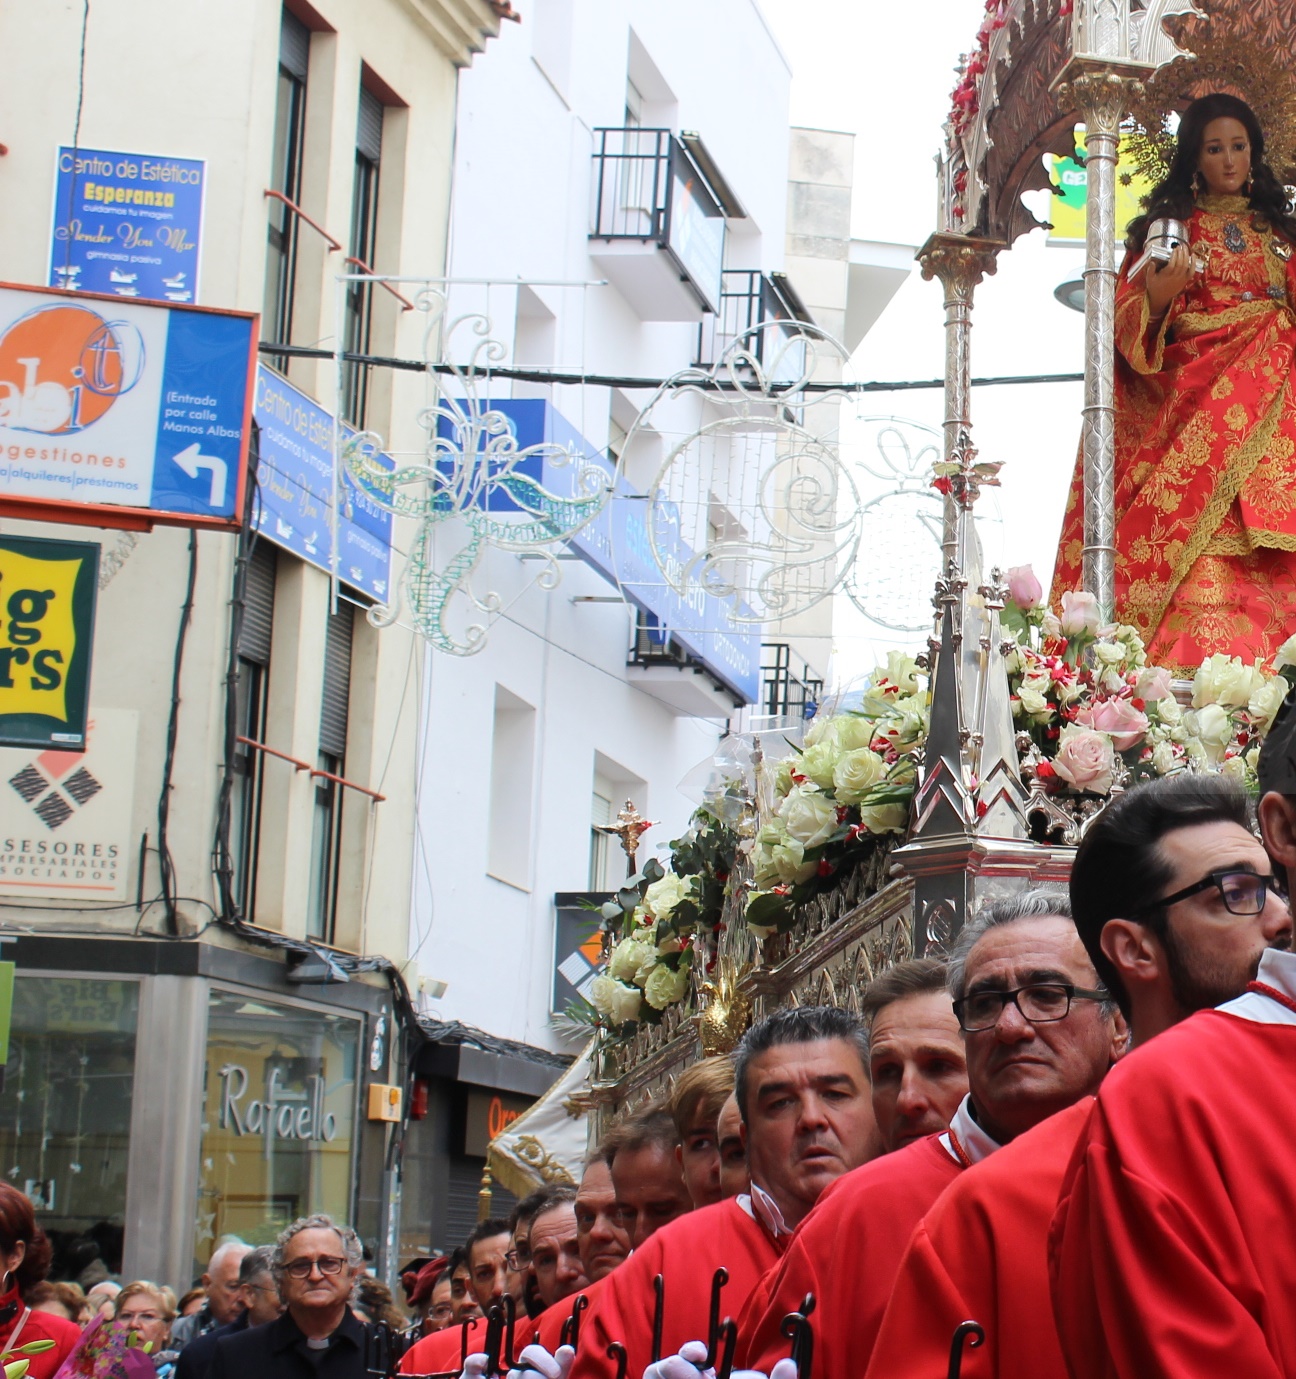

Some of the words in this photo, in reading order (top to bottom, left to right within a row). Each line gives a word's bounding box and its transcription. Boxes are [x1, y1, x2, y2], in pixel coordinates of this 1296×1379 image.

[59, 153, 113, 177] Centro
[115, 160, 139, 180] de
[141, 161, 200, 185] Estética
[83, 182, 175, 208] Esperanza
[82, 204, 128, 216] cuidamos
[128, 207, 138, 217] tu
[138, 208, 174, 221] imagen
[116, 221, 154, 250] You
[156, 225, 196, 253] Mar
[129, 254, 162, 266] pasiva
[166, 391, 218, 407] (Entrada
[257, 376, 294, 427] Centro
[292, 404, 308, 438] de
[164, 407, 186, 421] por
[188, 409, 218, 422] calle
[162, 421, 204, 436] Manos
[218, 1063, 337, 1150] Rafaello
